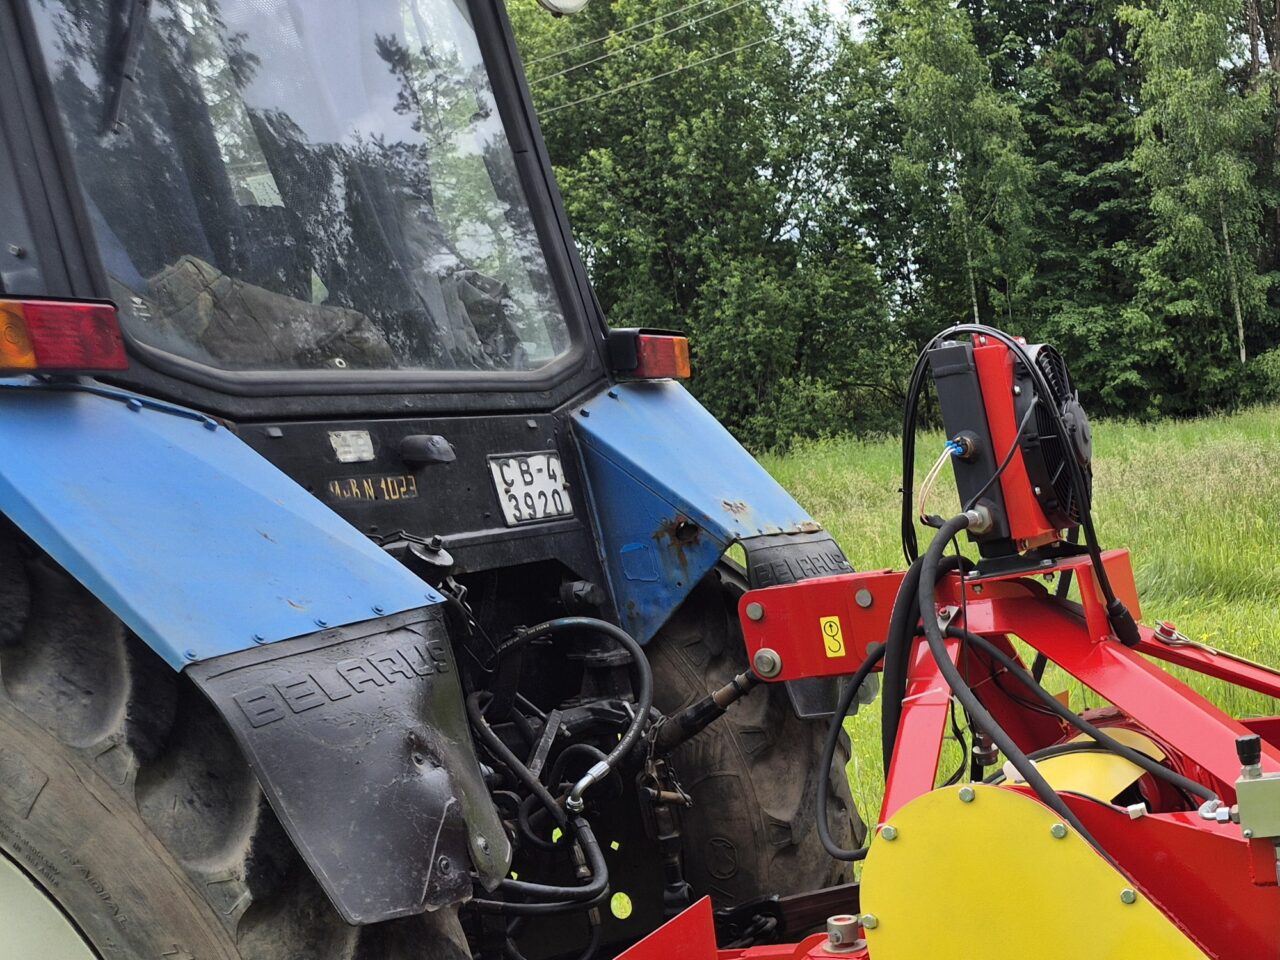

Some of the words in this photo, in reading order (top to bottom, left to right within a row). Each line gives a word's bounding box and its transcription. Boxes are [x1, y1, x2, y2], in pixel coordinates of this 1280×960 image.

[499, 456, 558, 488] CB-4
[508, 488, 565, 522] 3920
[232, 639, 449, 729] BELARUS
